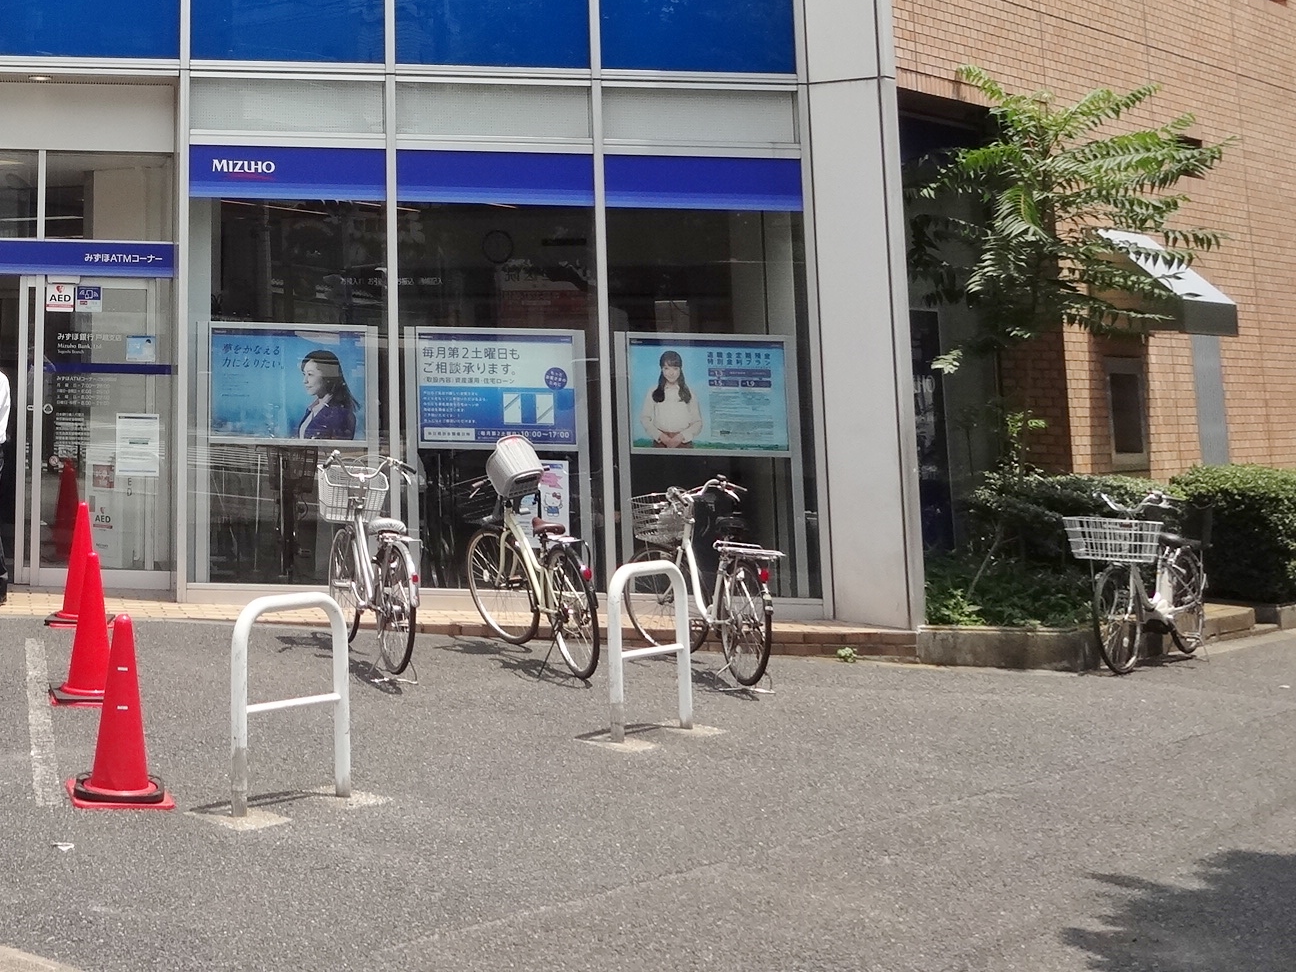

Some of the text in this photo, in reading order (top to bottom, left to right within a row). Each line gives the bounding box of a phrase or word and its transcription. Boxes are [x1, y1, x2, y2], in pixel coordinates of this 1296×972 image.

[212, 159, 276, 173] MIZUHO
[84, 253, 163, 263] みずほATMコーナー
[49, 294, 71, 302] AED
[57, 333, 93, 341] みずほ銀行
[222, 344, 280, 355] 夢をかなえる
[422, 346, 520, 360] 毎月第2土曜日も
[222, 358, 285, 370] 力になりたい。
[423, 362, 516, 376] ご相談承ります。
[95, 515, 111, 523] AED
